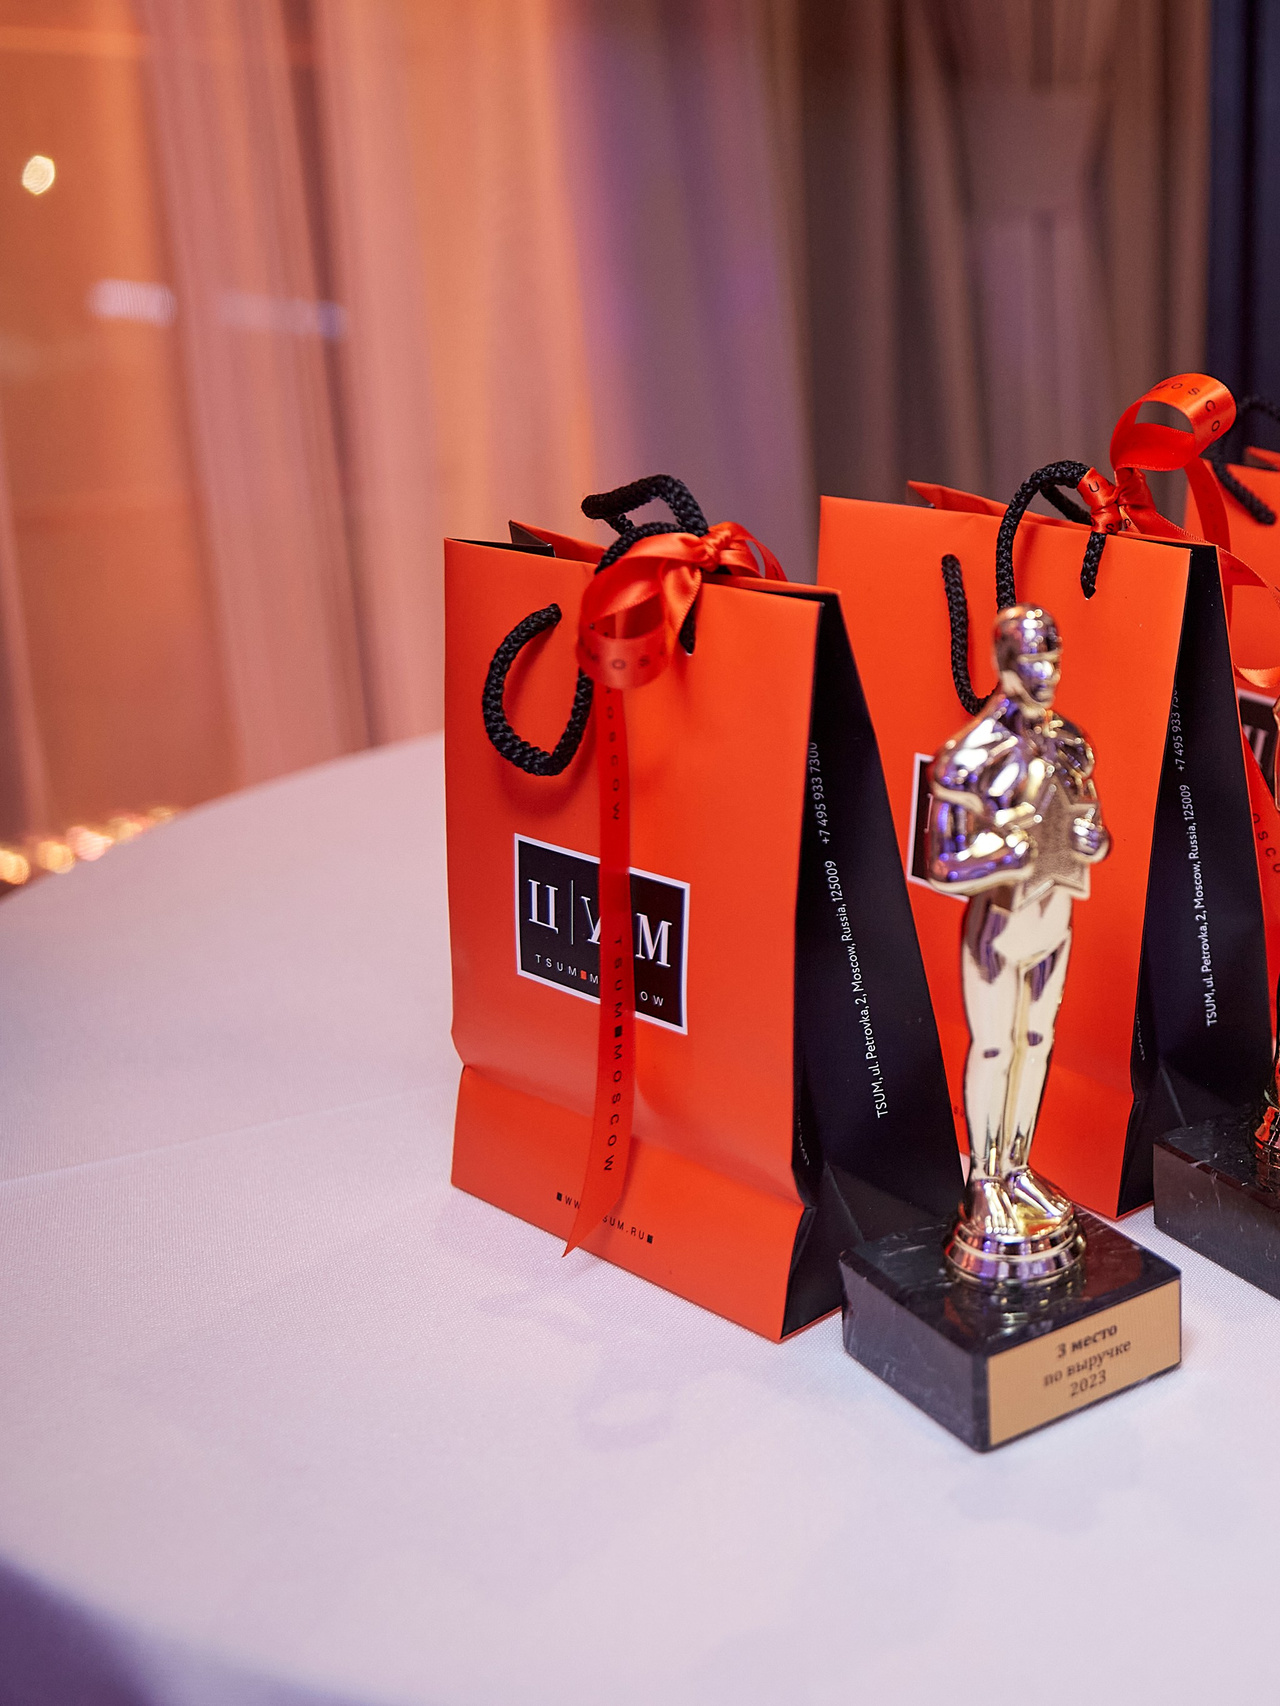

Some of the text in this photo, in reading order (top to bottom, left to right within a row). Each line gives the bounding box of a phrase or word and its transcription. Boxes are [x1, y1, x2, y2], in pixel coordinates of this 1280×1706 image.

[1155, 382, 1221, 432] MOSCO
[1170, 712, 1182, 733] 933
[605, 687, 620, 820] OSCOW
[1172, 735, 1185, 756] 495
[1174, 758, 1186, 772] +7
[810, 776, 825, 800] 933
[1179, 784, 1195, 821] 125009
[814, 803, 829, 827] 495
[818, 829, 831, 844] +7
[1186, 822, 1199, 860] Russia,
[824, 860, 844, 902] 125009
[1192, 861, 1205, 909] Moscow,
[836, 903, 853, 941] Russia,
[1195, 910, 1208, 921] 2,
[1198, 922, 1213, 973] Petrovka,
[535, 953, 664, 1007] TSUM MOW
[847, 943, 865, 992] Moscow,
[1202, 974, 1214, 988] ul.
[854, 994, 868, 1005] 2,
[1204, 988, 1218, 1028] TSUM,
[858, 1005, 878, 1060] Petrovka,
[868, 1061, 881, 1076] ul.
[604, 1044, 623, 1171] MOSCOW
[871, 1077, 889, 1119] TSUM,
[564, 1195, 645, 1241] WWSUM.RU
[1056, 1324, 1118, 1359] 3 место
[1043, 1340, 1132, 1388] по выручке
[1069, 1369, 1108, 1398] 2023
